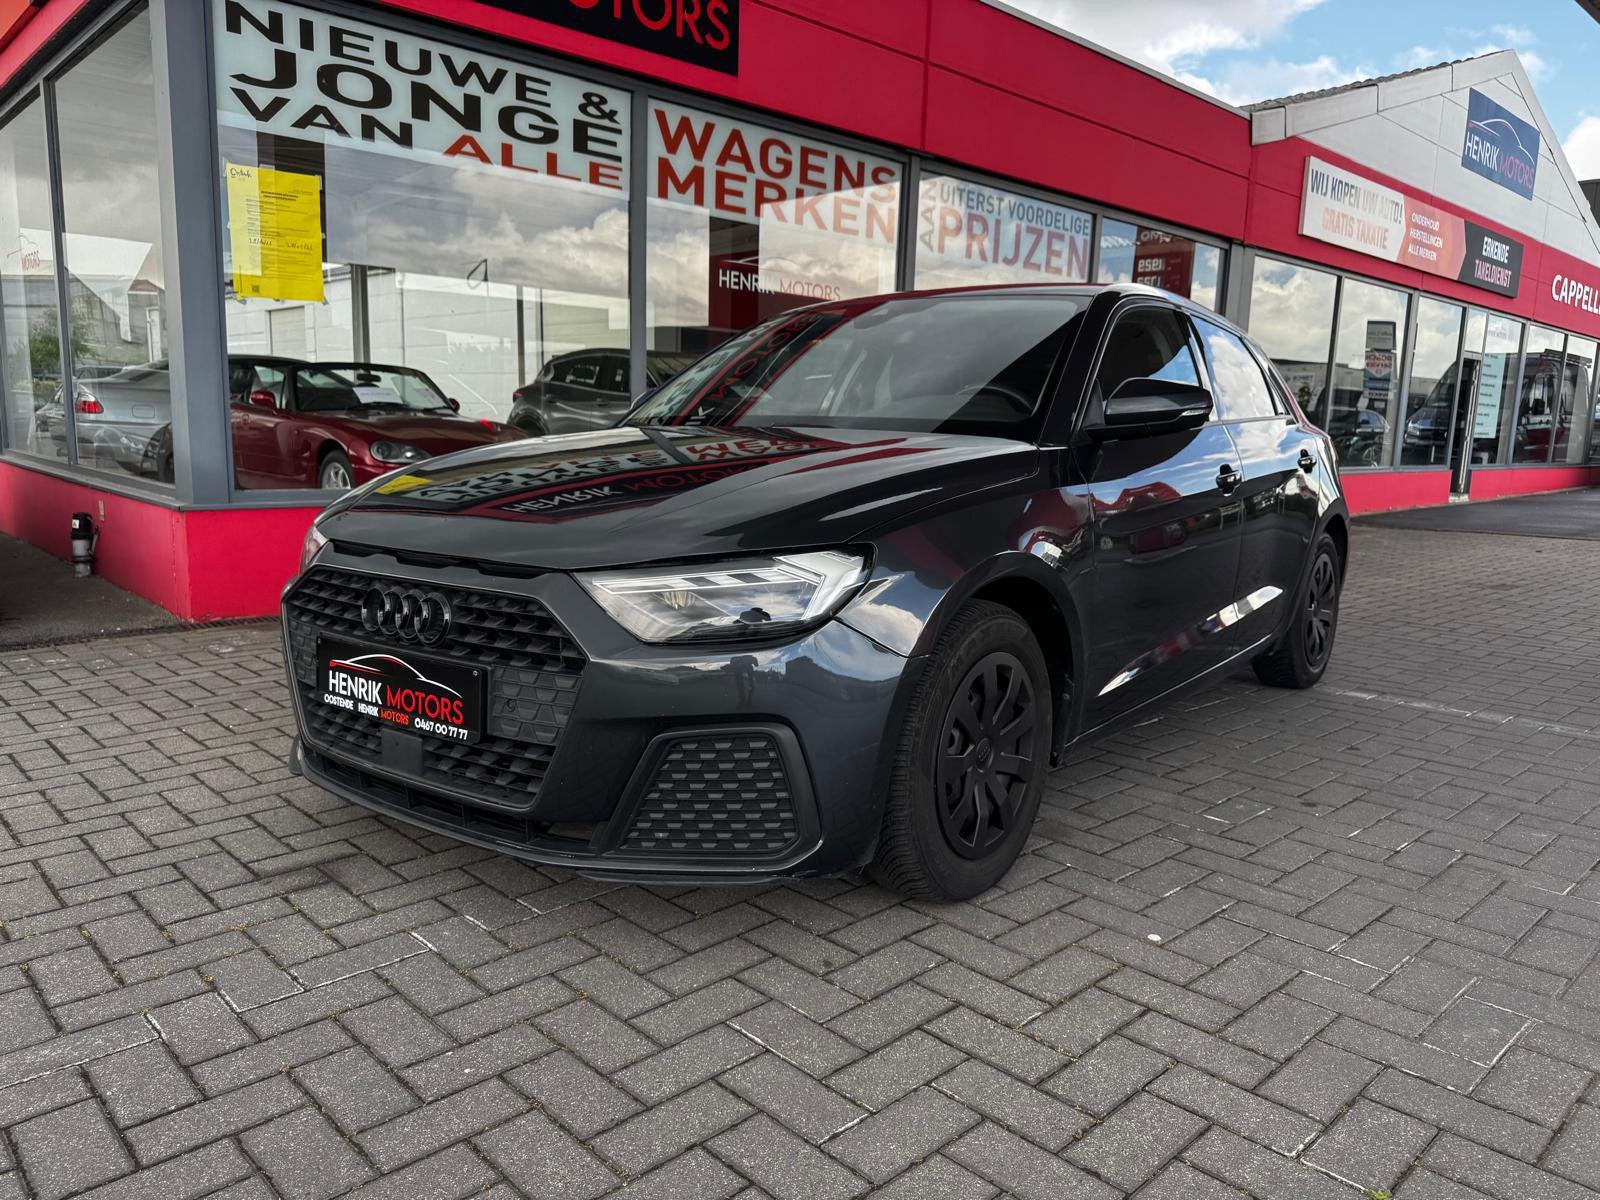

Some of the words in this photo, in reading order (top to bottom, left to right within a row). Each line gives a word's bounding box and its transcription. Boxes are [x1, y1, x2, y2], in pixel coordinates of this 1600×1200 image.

[225, 0, 551, 108] NIEUWE
[578, 92, 620, 124] &
[229, 49, 623, 163] JONGE
[229, 87, 413, 150] VAN
[443, 134, 623, 190] ALLE
[654, 109, 897, 203] WAGENS
[1464, 131, 1500, 172] HENRIK
[1500, 152, 1536, 190] MOTORS
[658, 157, 896, 244] MERKEN
[940, 183, 1003, 216] UITERST
[1008, 200, 1090, 236] VOORDELIGE
[1311, 168, 1329, 197] WIJ
[1330, 176, 1361, 210] KOPEN
[937, 207, 1089, 280] PRIJZEN
[1322, 207, 1355, 238] GRATIS
[1482, 236, 1510, 264] ERKENDE
[719, 268, 775, 295] HENRIK
[779, 279, 841, 300] MOTORS
[1552, 274, 1600, 315] CAPPELL
[324, 693, 354, 711] OOSTENDE
[357, 702, 379, 718] HENRIK
[380, 709, 410, 726] MOTORS
[414, 716, 434, 732] 0467
[434, 723, 448, 735] 00
[448, 725, 458, 739] 77
[458, 727, 468, 740] 77
[328, 669, 382, 705] HENRIK
[386, 684, 464, 725] MOTORS
